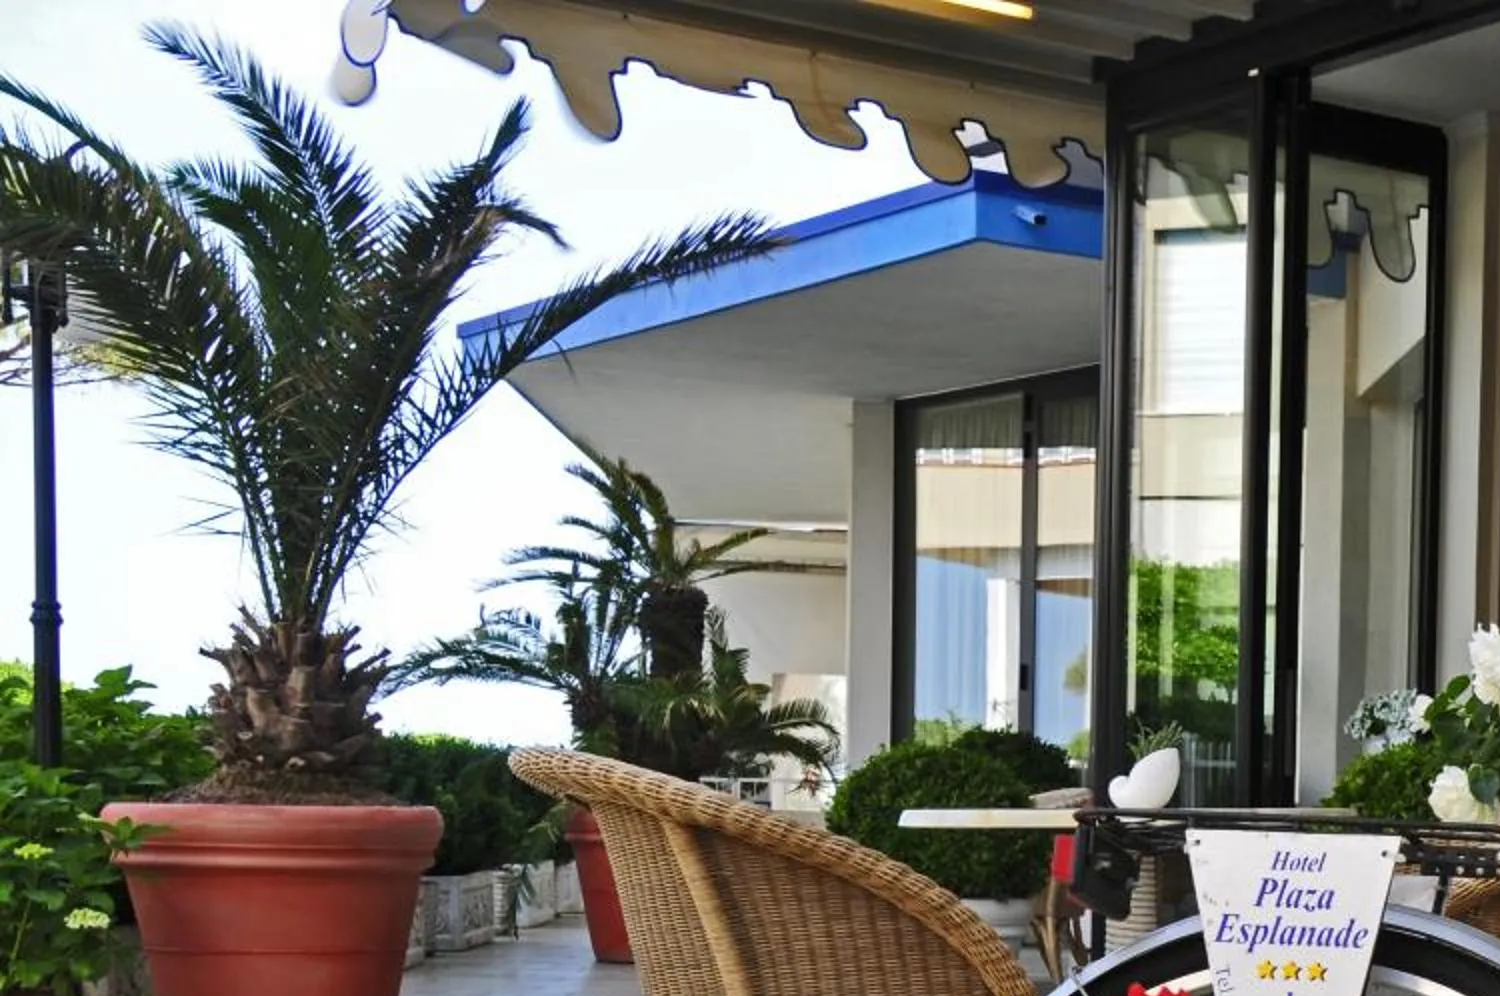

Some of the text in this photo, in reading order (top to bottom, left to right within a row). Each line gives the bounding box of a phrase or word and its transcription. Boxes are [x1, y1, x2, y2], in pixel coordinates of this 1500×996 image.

[1271, 851, 1327, 873] Hotel
[1253, 877, 1335, 912] Plaza
[1214, 913, 1370, 953] Esplanade
